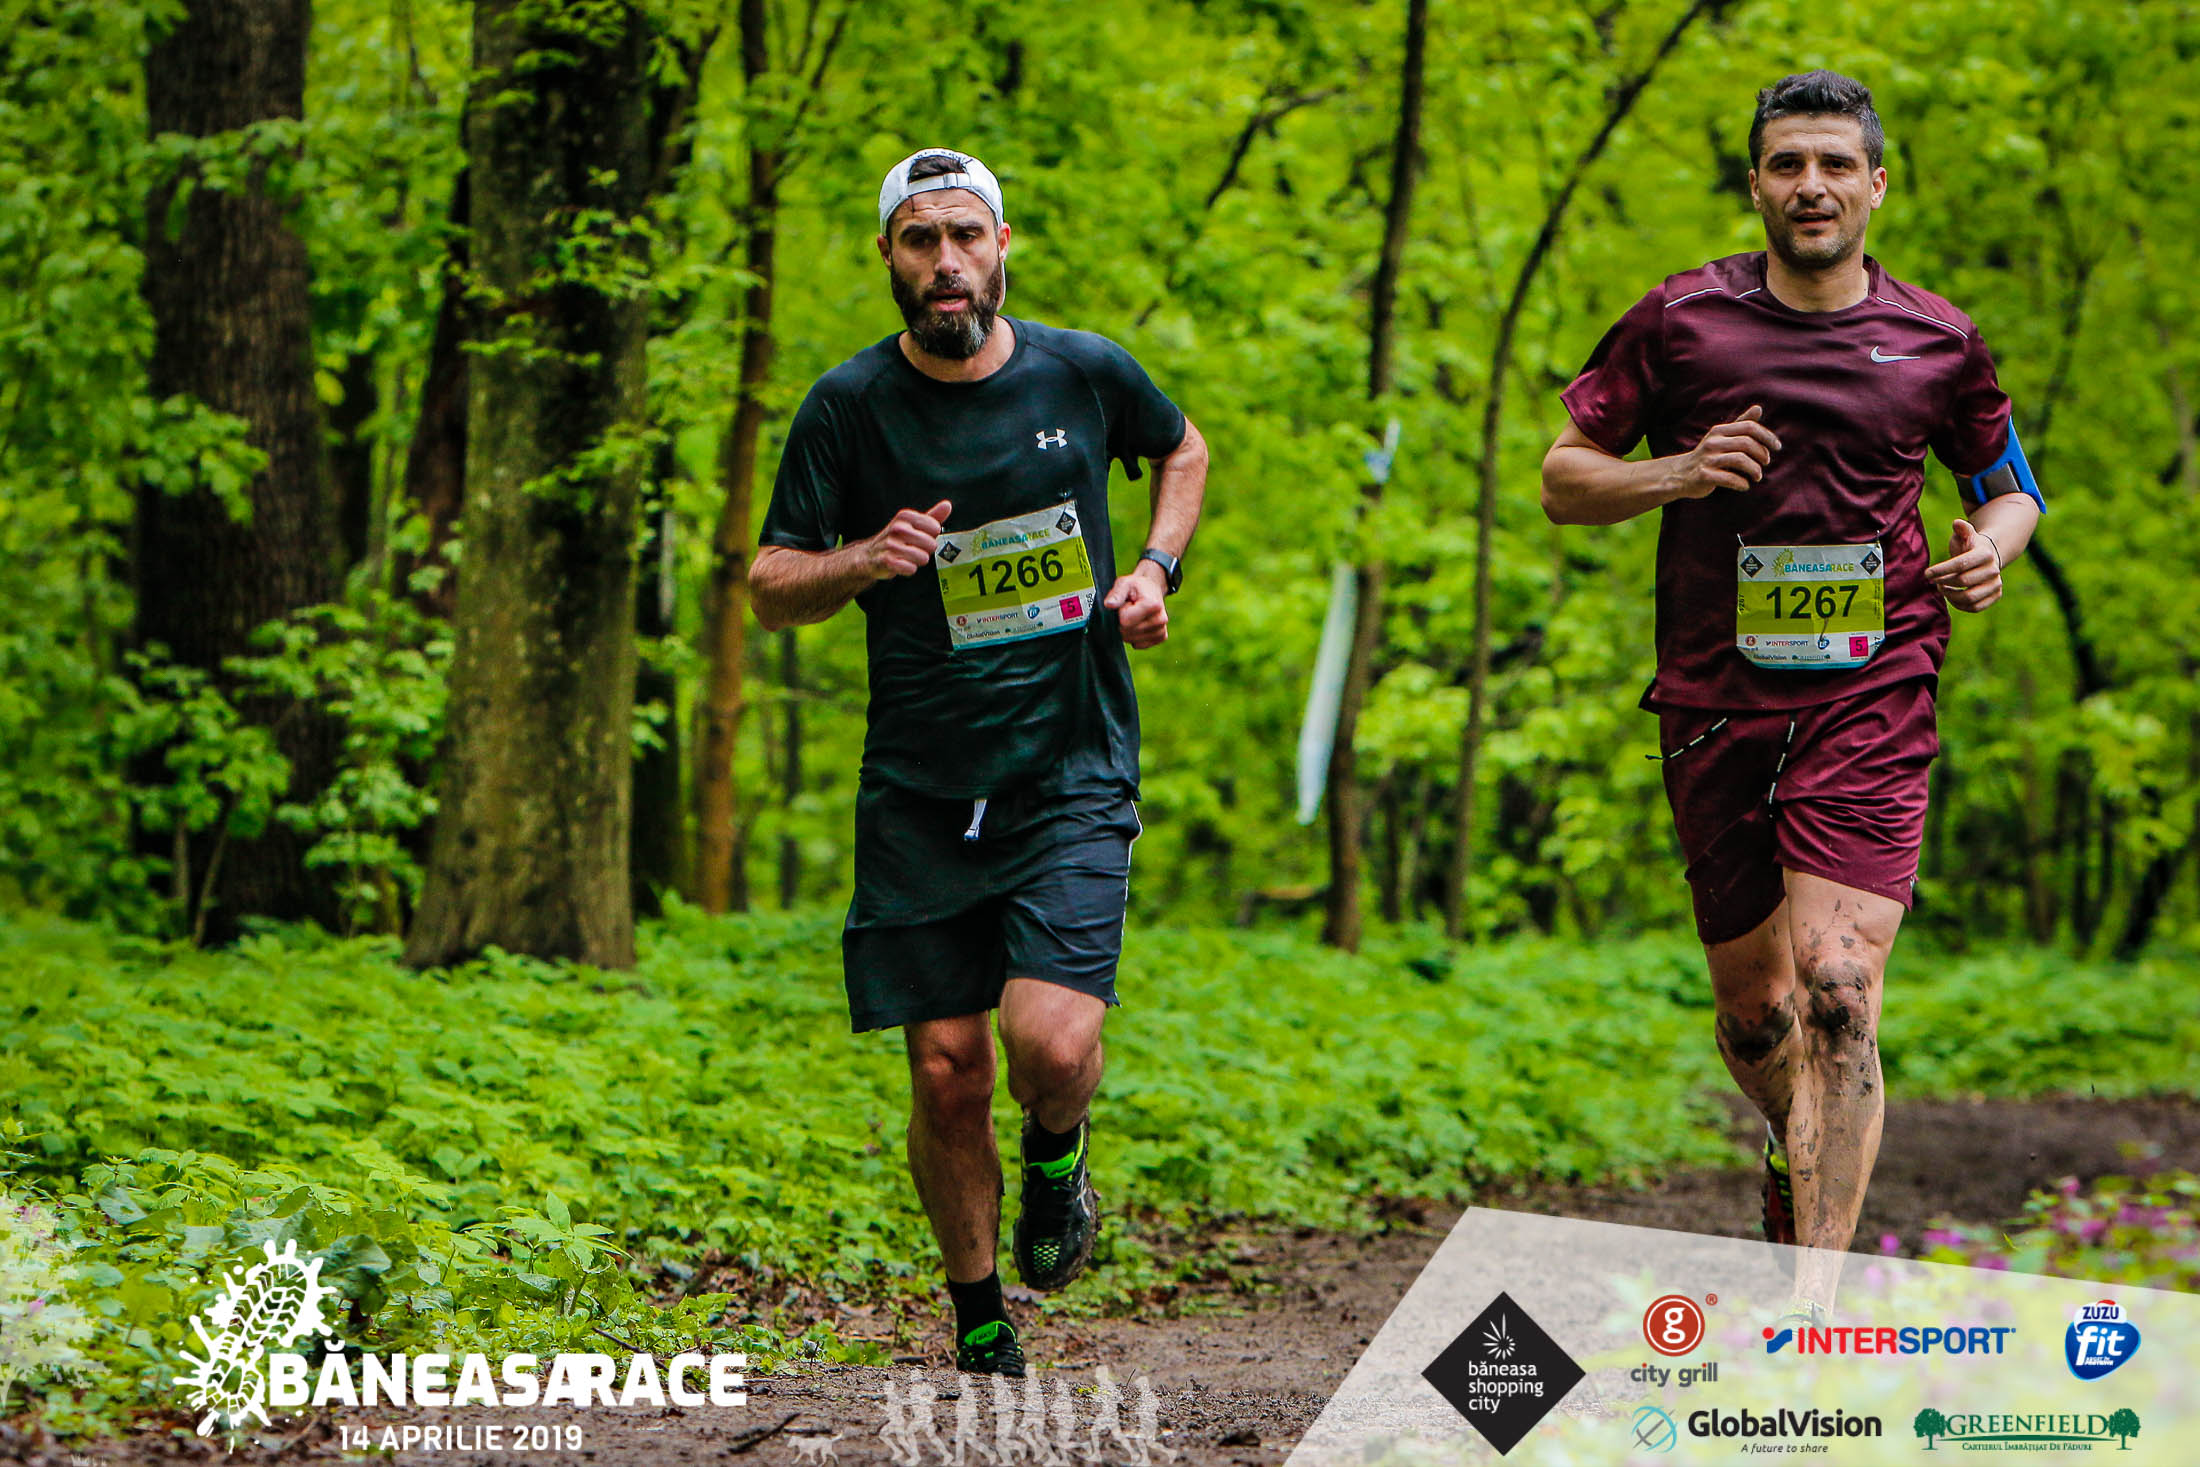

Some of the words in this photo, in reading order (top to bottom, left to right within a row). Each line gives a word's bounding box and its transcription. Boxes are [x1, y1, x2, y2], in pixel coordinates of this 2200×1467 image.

[968, 548, 1065, 597] 1266
[1066, 600, 1076, 613] 5
[1765, 585, 1860, 620] 1267
[1855, 639, 1863, 652] 5
